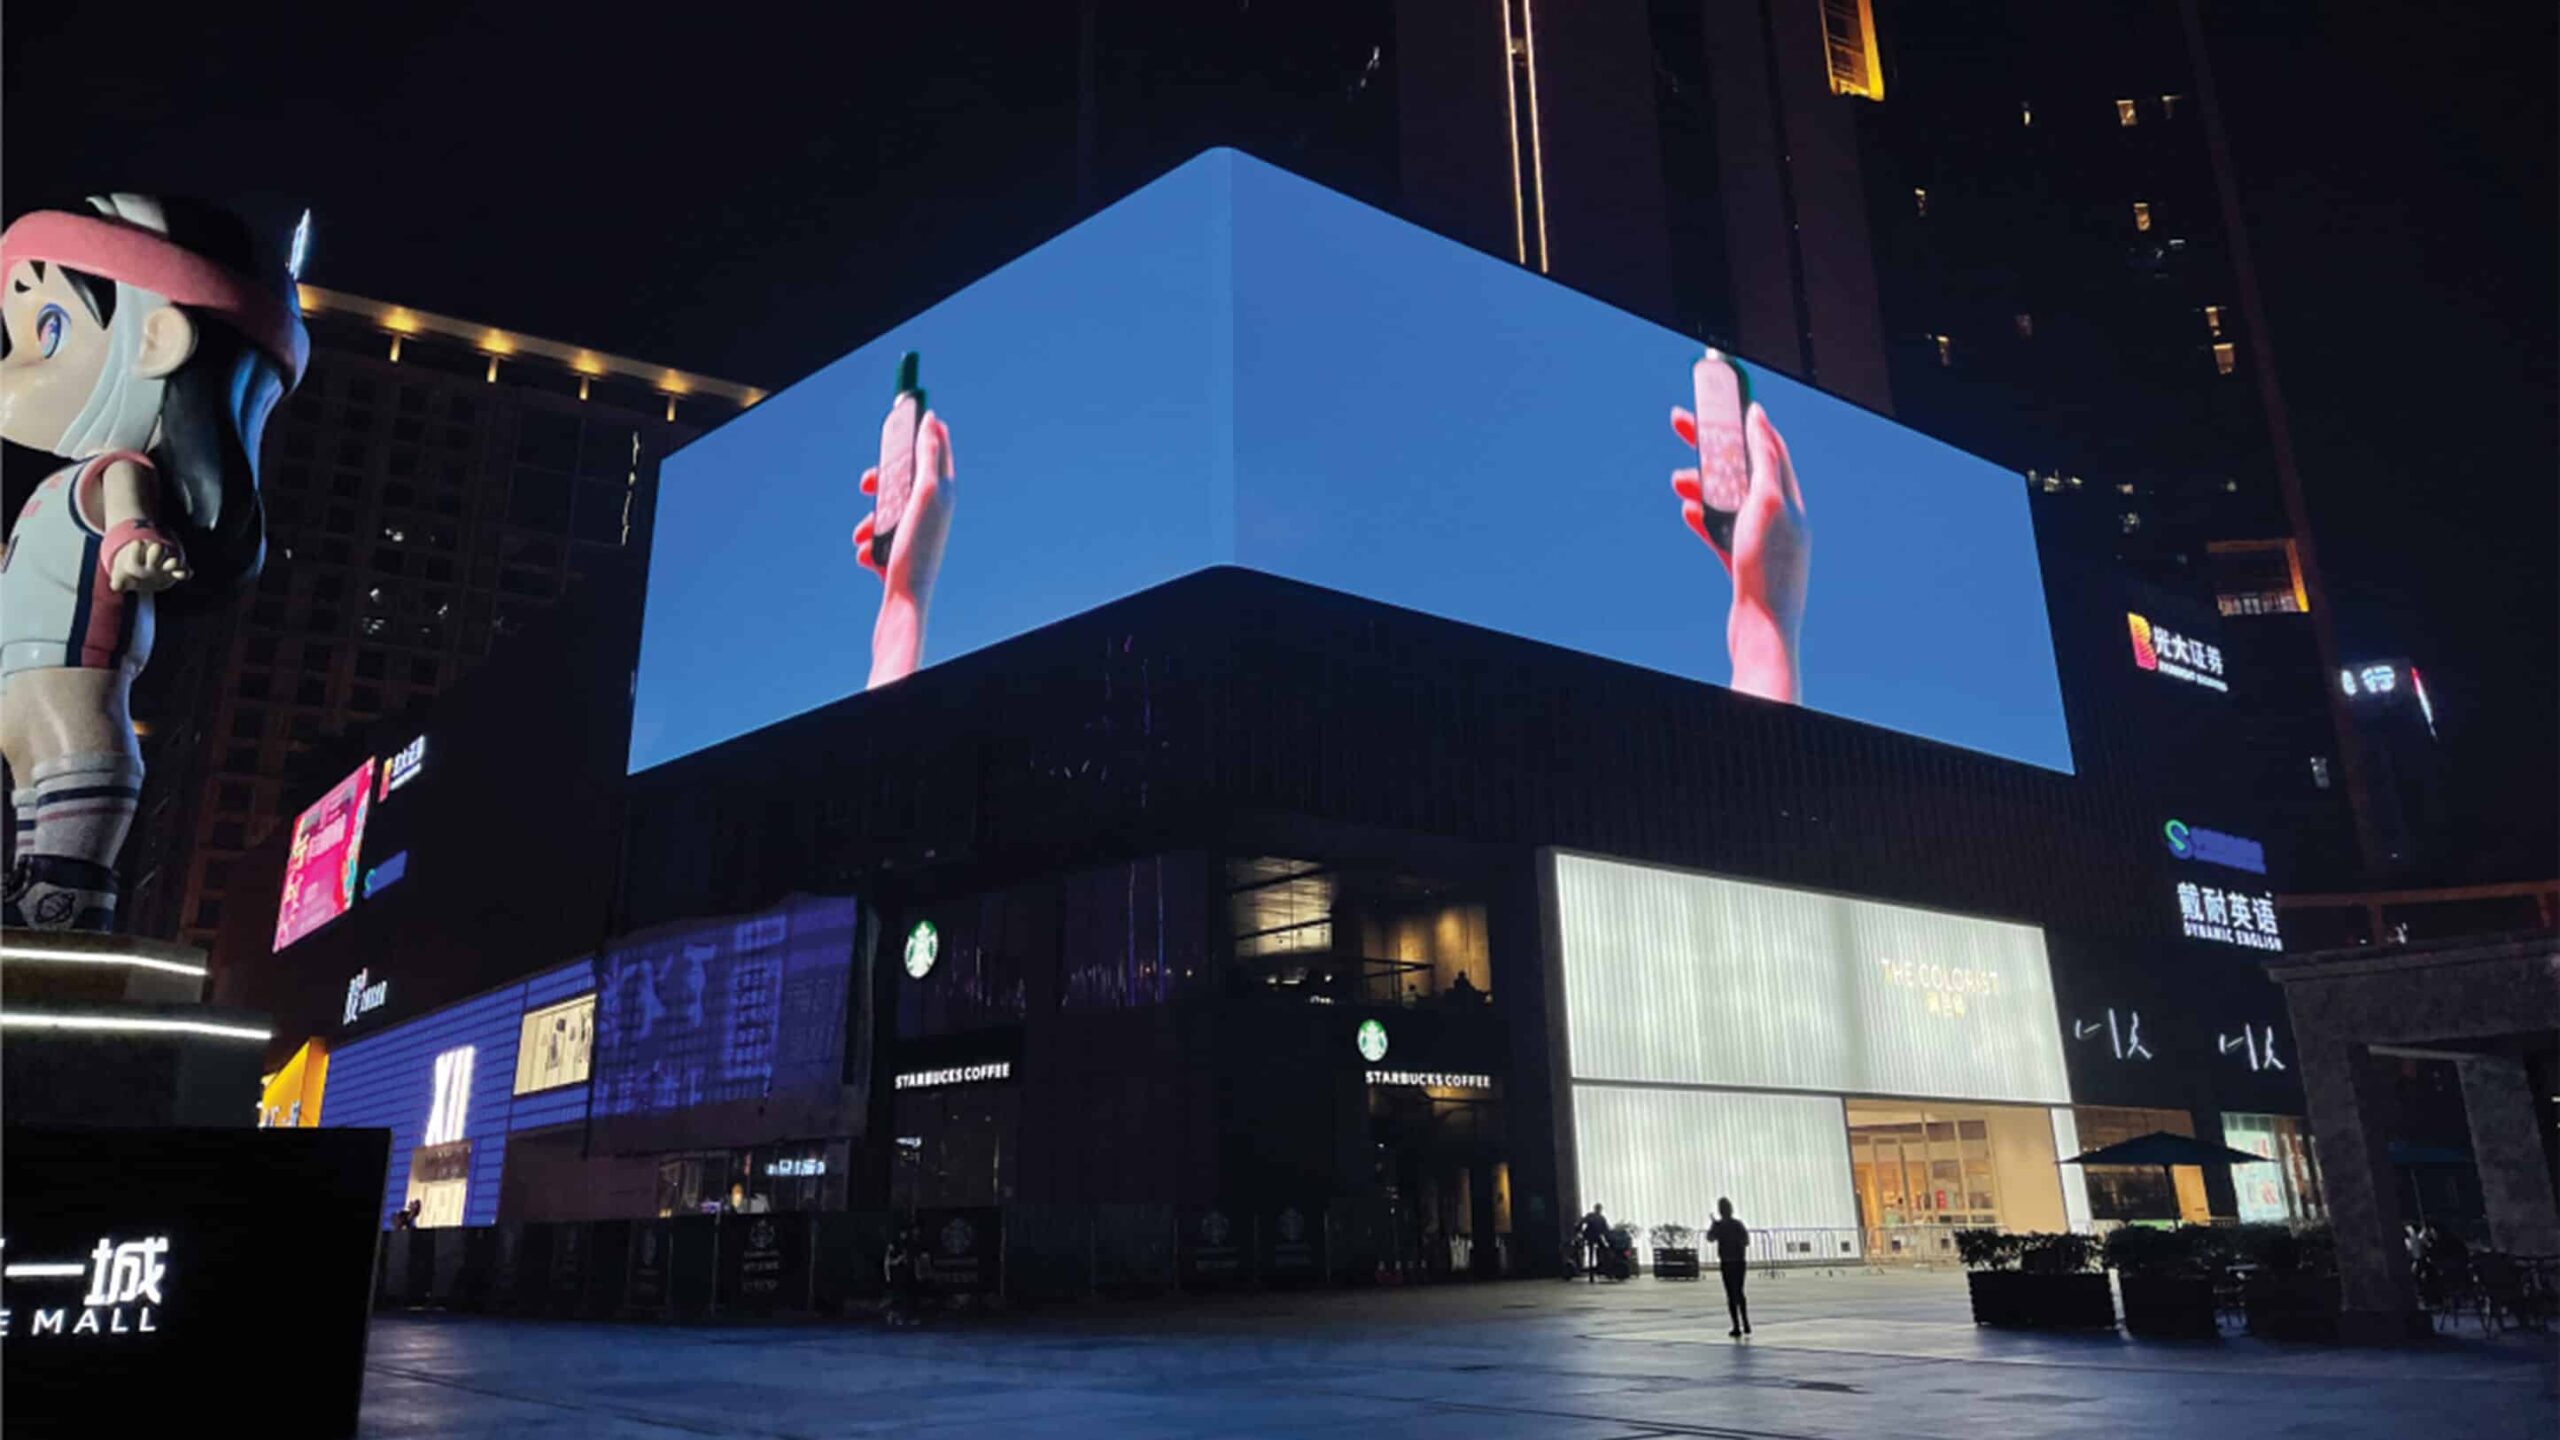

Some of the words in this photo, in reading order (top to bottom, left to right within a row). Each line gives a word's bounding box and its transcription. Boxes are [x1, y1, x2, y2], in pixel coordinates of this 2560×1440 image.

[2153, 625, 2223, 675] 光大证券
[2236, 929, 2283, 951] ENGLISH
[1881, 957, 1914, 987] THE
[895, 1067, 962, 1089] STARBUCKS
[964, 1062, 1010, 1081] COFFEE
[1366, 1071, 1443, 1086] STARBUCKS
[1445, 1074, 1491, 1088] COFFEE
[31, 1307, 157, 1336] MALL
